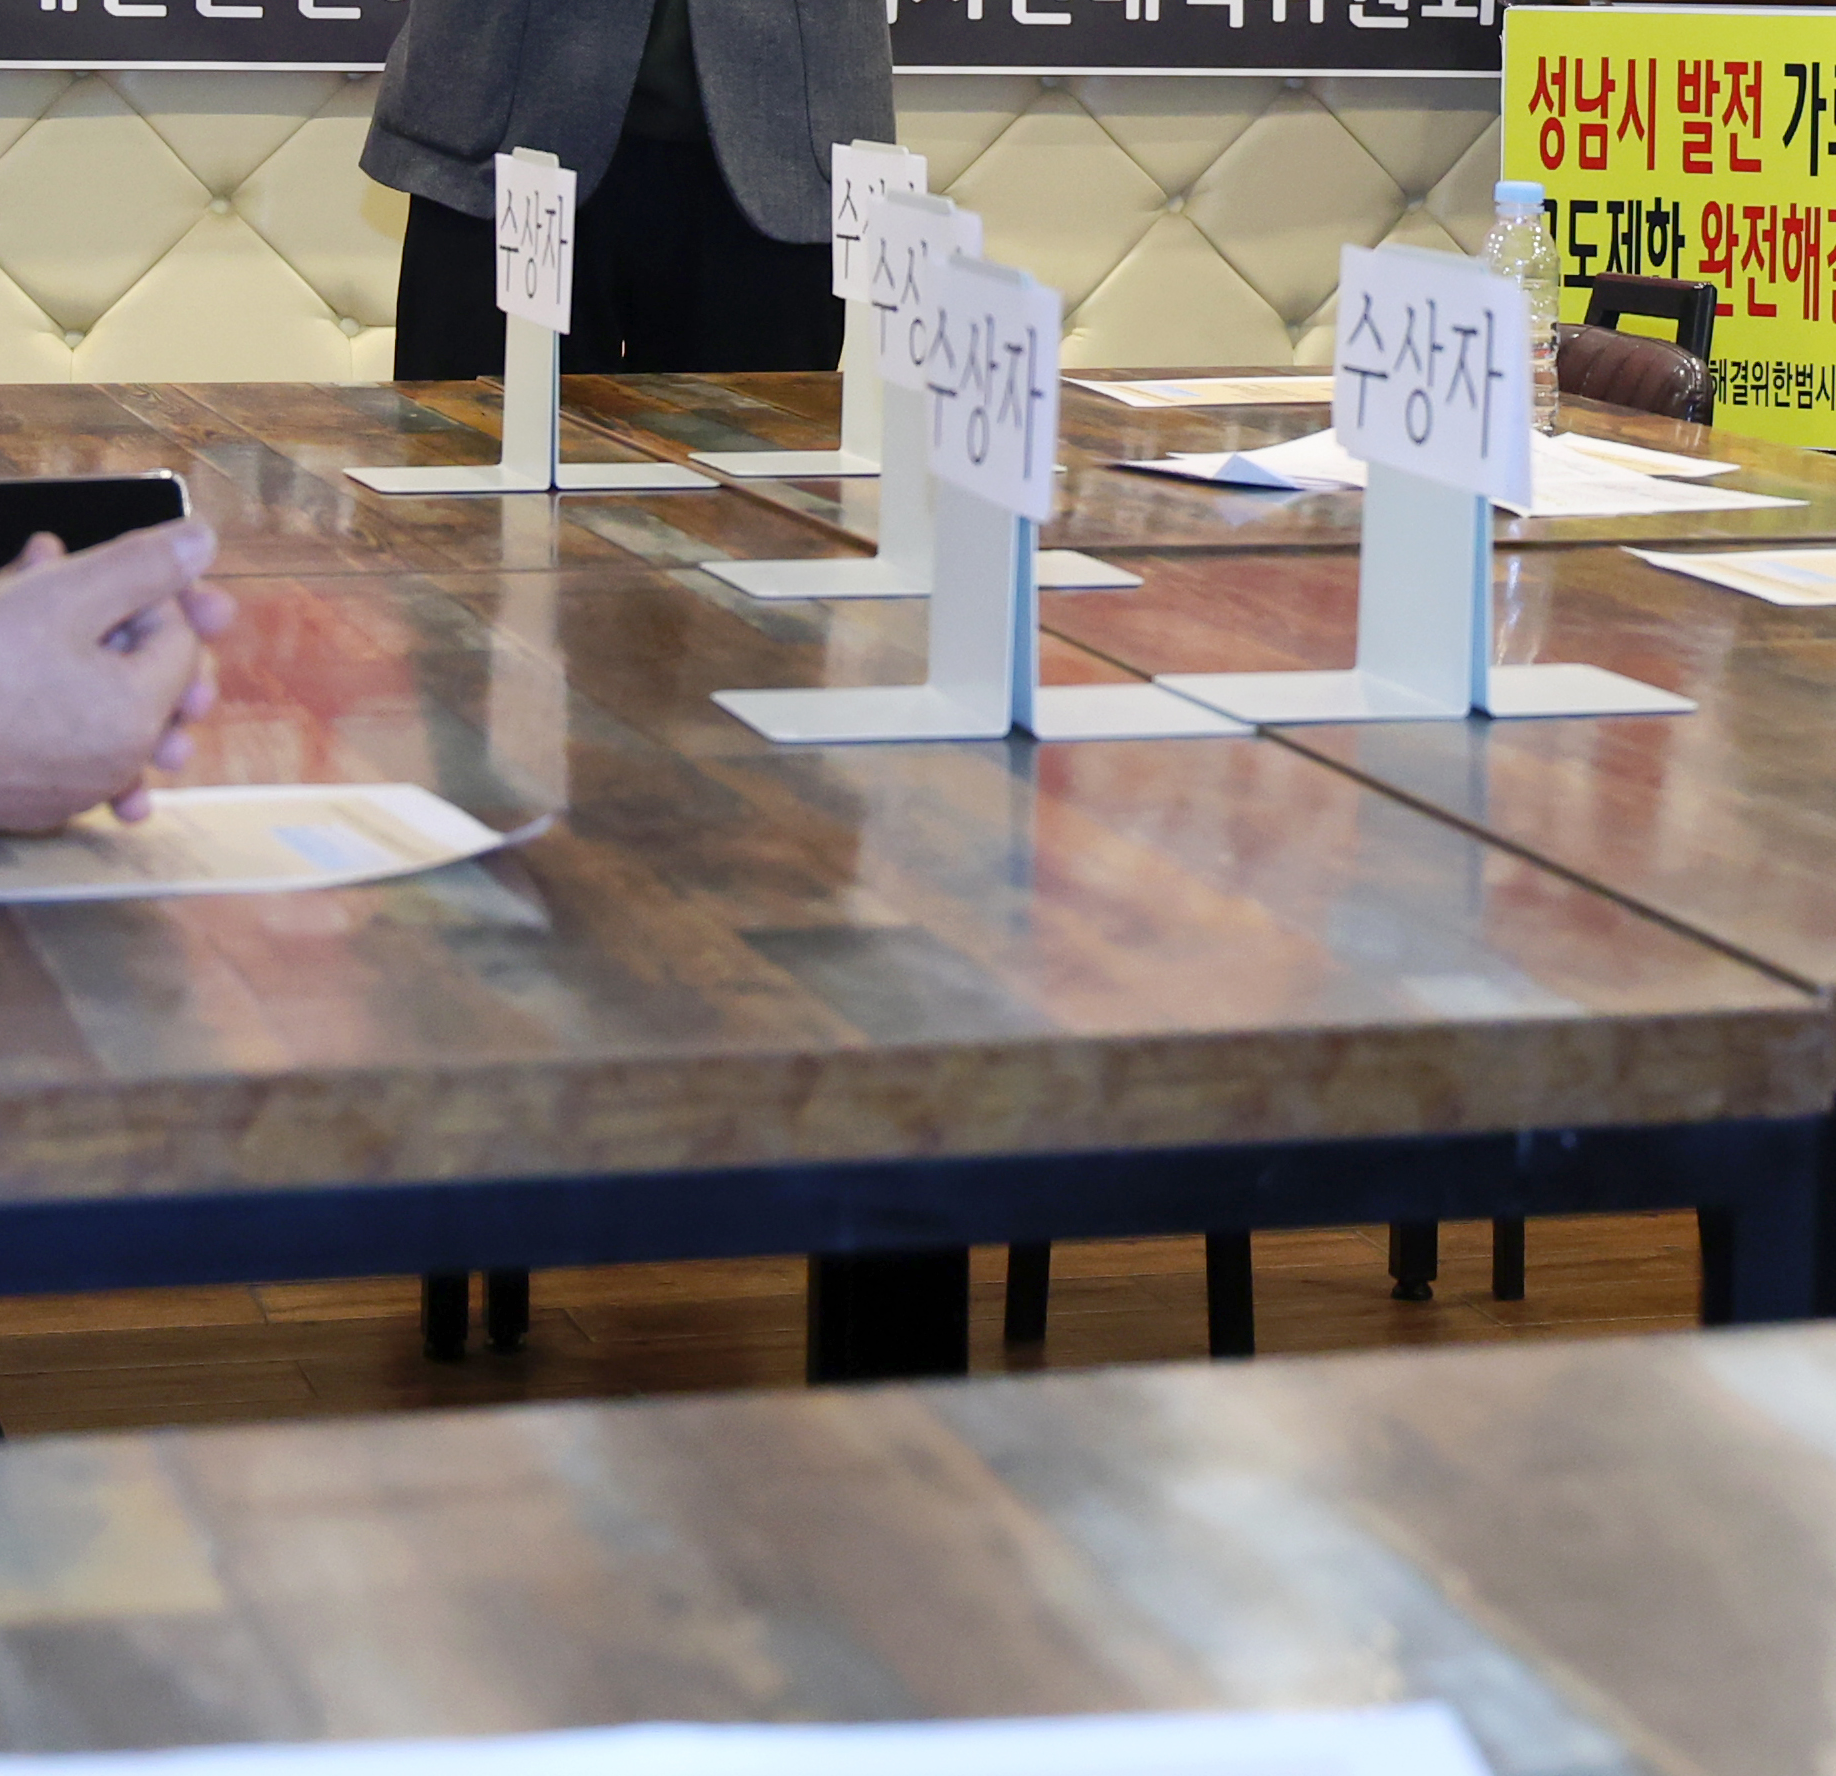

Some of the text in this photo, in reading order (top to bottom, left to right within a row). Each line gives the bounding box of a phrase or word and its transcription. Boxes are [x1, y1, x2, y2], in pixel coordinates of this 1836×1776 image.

[1528, 55, 1658, 171] 성남시
[1676, 59, 1763, 175] 발전
[499, 188, 569, 305] 수상자
[1542, 196, 1687, 289] 도제한
[926, 305, 1045, 480] 수상자
[1341, 291, 1505, 460] 수상자
